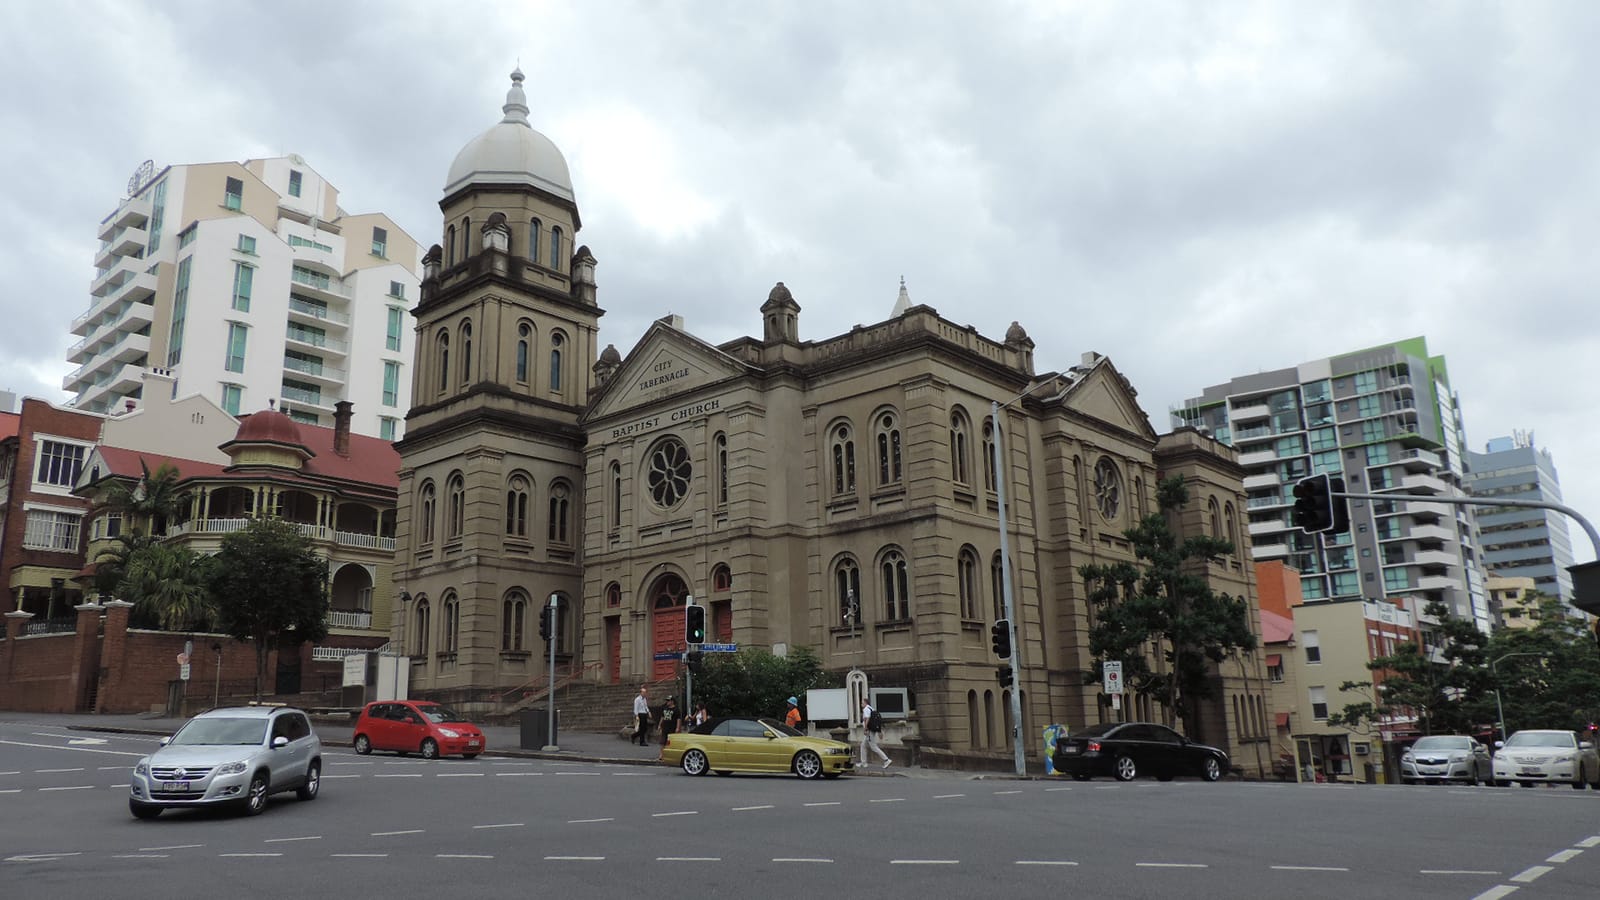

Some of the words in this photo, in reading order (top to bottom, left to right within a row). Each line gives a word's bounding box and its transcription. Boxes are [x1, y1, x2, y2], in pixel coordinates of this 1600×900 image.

[654, 360, 673, 372] CITY
[640, 367, 690, 390] TABERNACLE
[612, 418, 660, 439] BAPTIST
[671, 399, 720, 421] CHURCH
